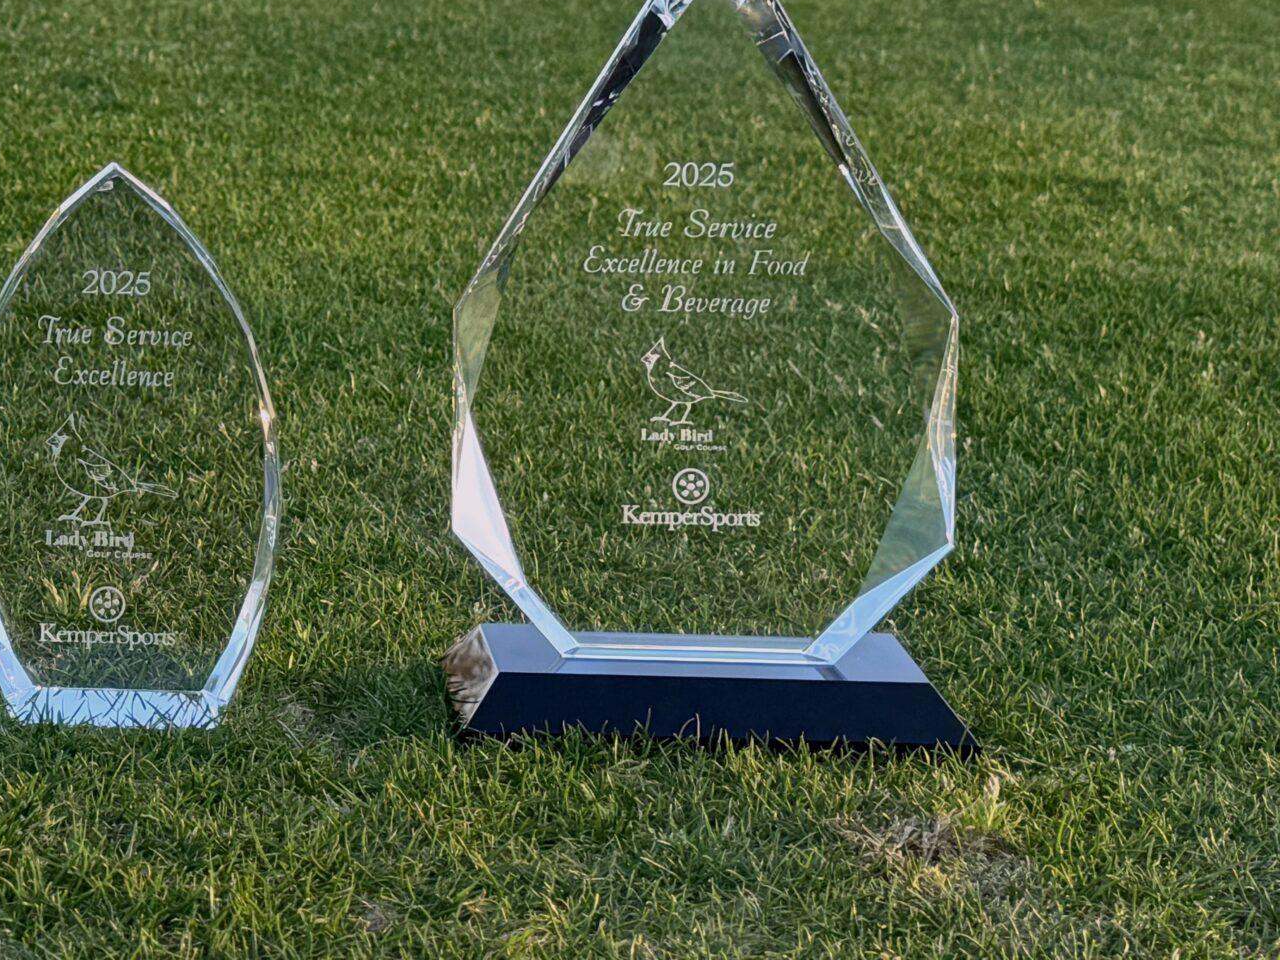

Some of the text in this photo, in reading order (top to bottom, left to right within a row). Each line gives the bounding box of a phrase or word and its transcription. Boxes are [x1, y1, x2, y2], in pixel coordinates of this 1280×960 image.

[662, 161, 735, 188] 2025
[618, 207, 778, 239] True Service
[583, 244, 811, 276] Excellence in Food
[81, 269, 152, 296] 2025
[621, 283, 772, 320] & Beverage
[37, 314, 193, 346] True Service
[53, 356, 175, 387] Excellence
[640, 427, 714, 445] Lady Bird
[620, 504, 761, 533] KemperSports
[45, 529, 135, 551] Lady Bird
[38, 622, 177, 651] KemperSports
